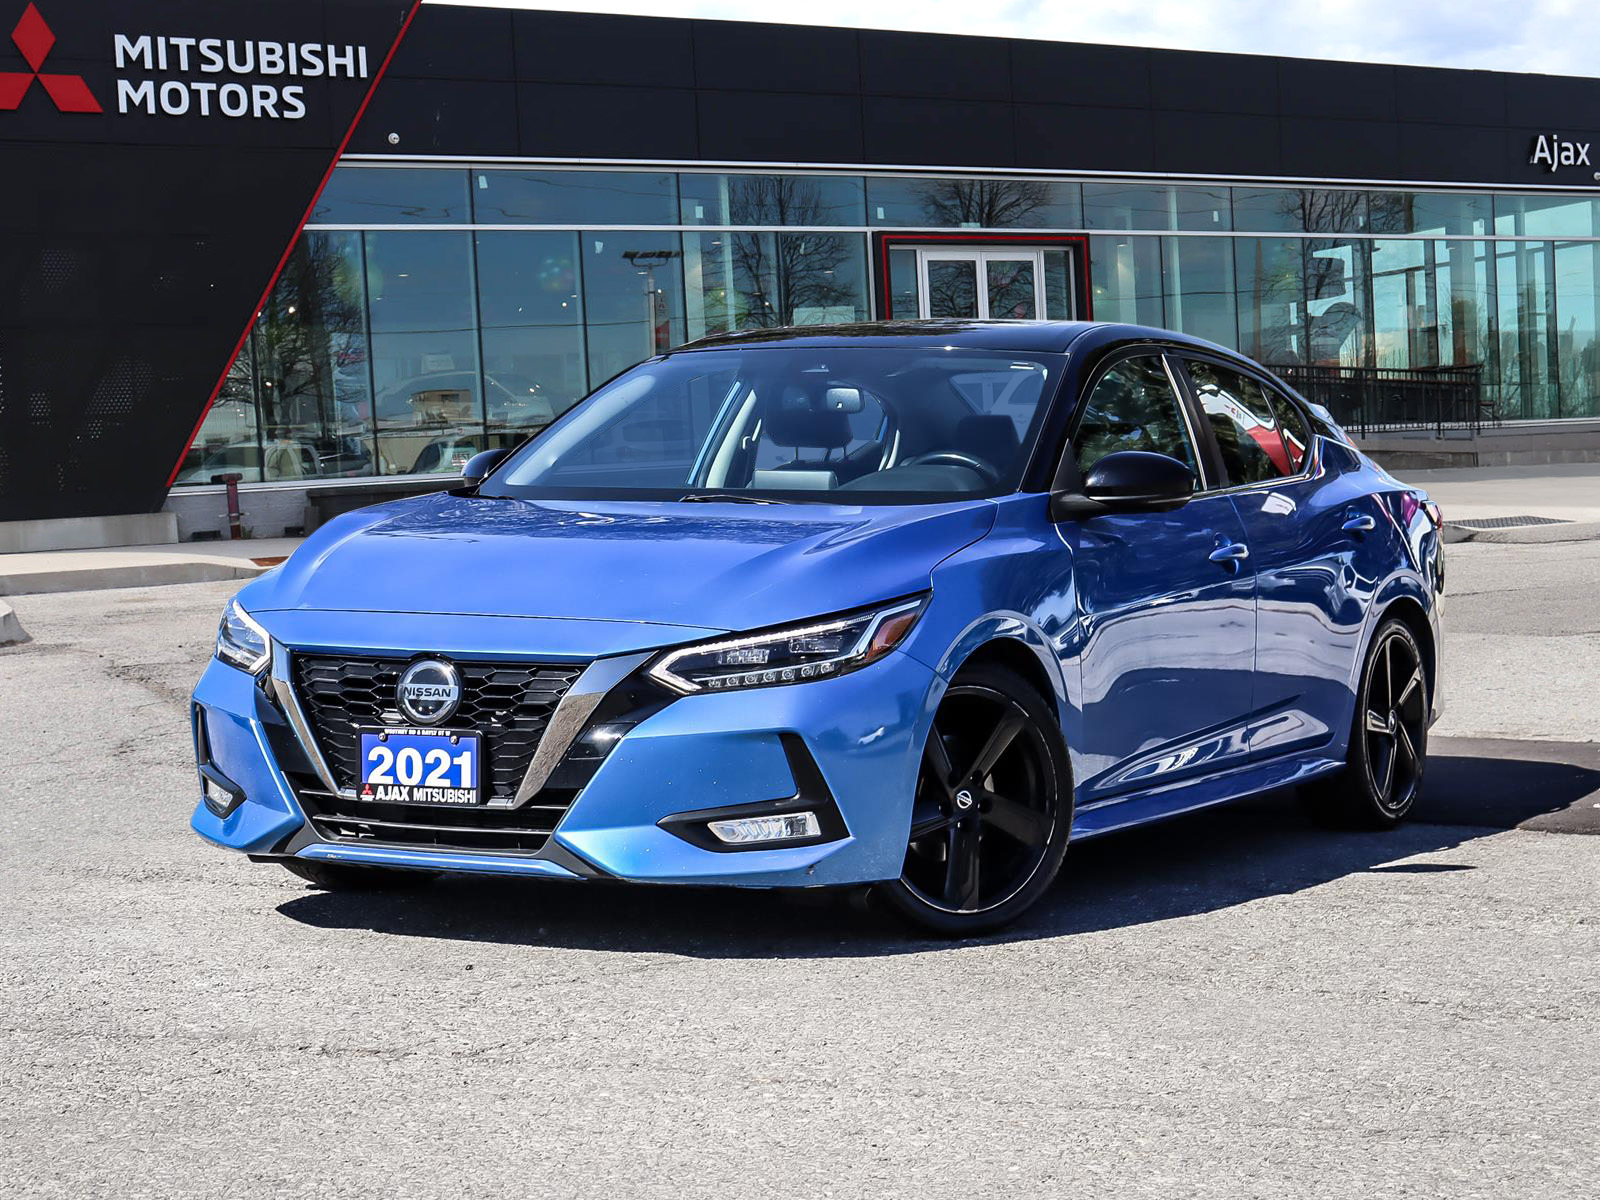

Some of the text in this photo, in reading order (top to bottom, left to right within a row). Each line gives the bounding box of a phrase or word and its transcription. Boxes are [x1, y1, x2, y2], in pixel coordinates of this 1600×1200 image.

[114, 33, 369, 79] MITSUBISHI
[116, 78, 308, 119] MOTORS
[1532, 134, 1592, 173] Ajax
[404, 687, 451, 698] NISSAN
[368, 746, 472, 788] 2021
[375, 785, 410, 801] AJAX
[413, 787, 477, 804] MITSUBISHI
